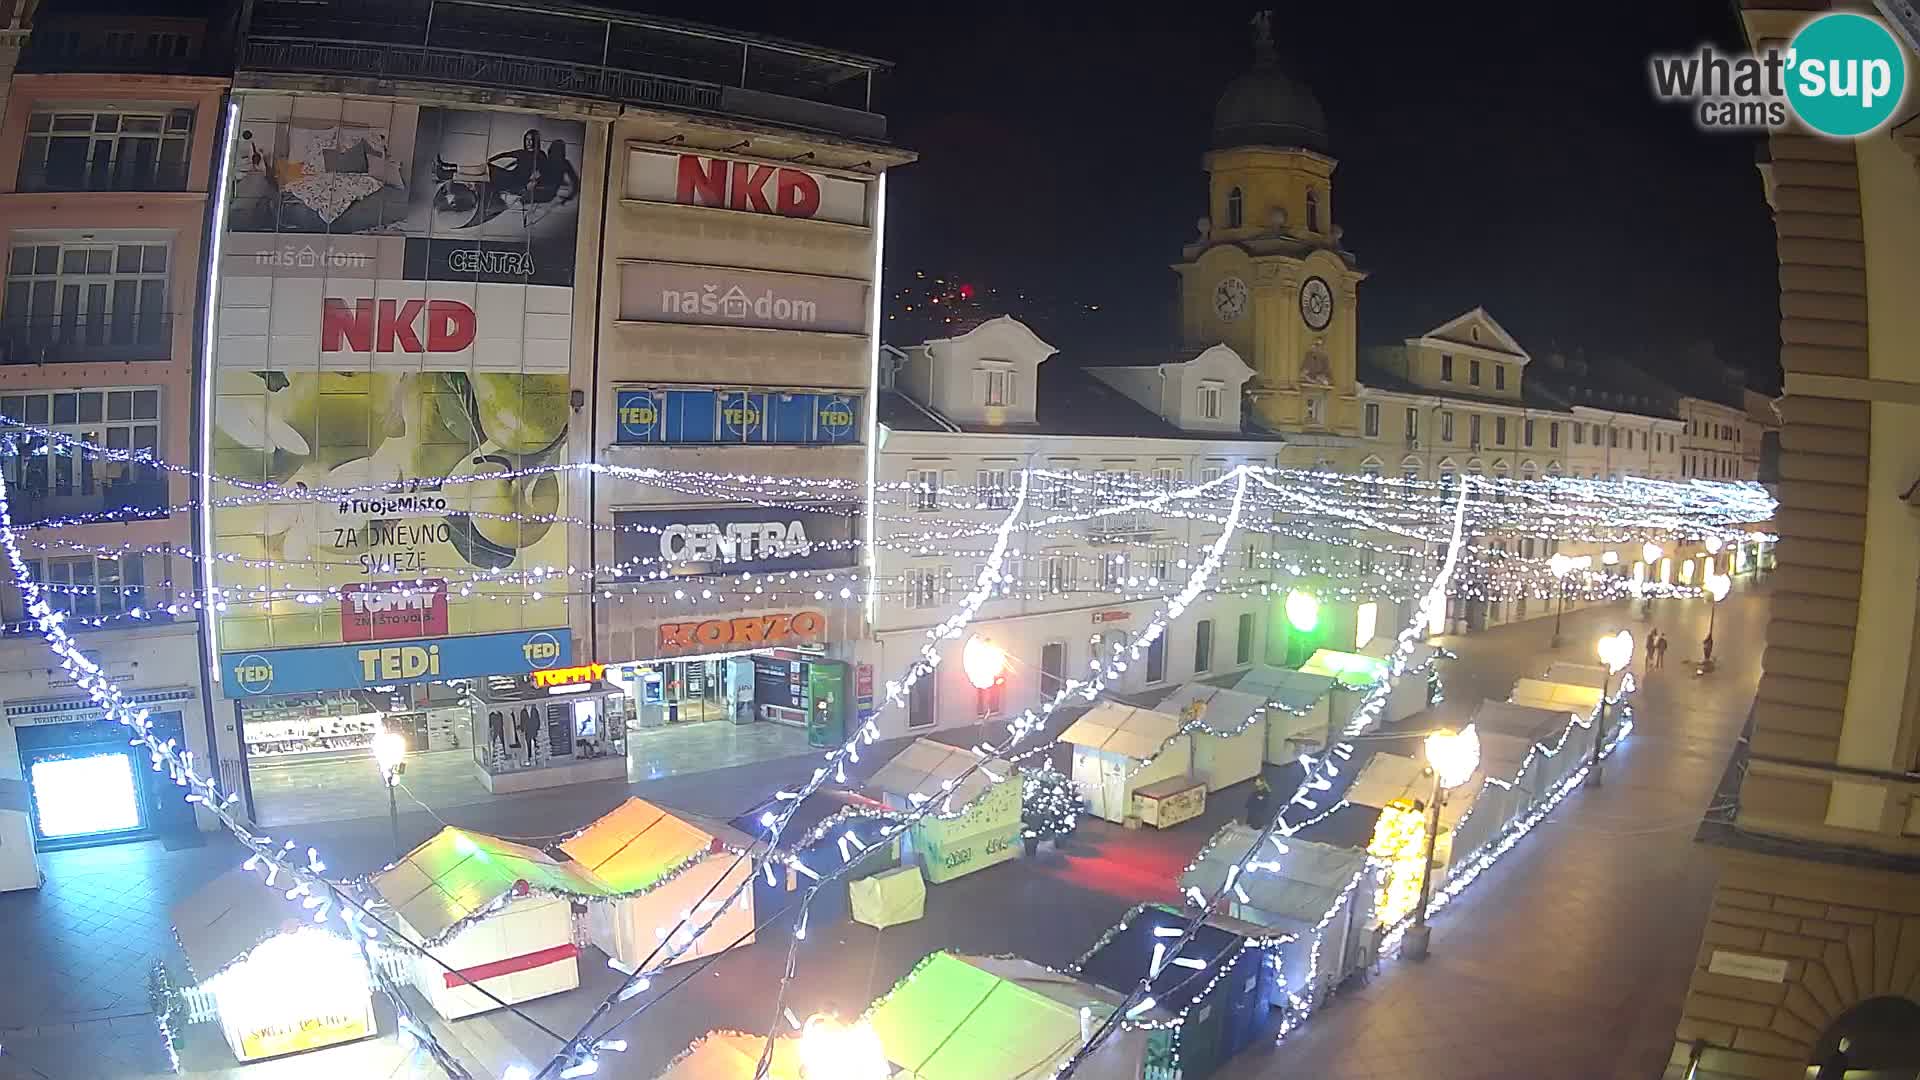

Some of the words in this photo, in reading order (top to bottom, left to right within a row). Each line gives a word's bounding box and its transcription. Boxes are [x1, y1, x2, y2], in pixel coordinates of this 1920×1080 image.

[676, 153, 821, 219] NKD
[448, 249, 535, 275] CENTRA
[661, 283, 718, 317] naš
[754, 288, 817, 323] dom
[322, 297, 478, 354] NKD
[618, 407, 658, 425] TEDi
[723, 409, 760, 426] TEDi
[820, 411, 854, 427] TEDi
[339, 496, 446, 516] #TvojeMisto
[334, 528, 358, 549] ZA
[369, 523, 451, 547] DNEVNO
[660, 520, 810, 562] CENTRA
[351, 588, 440, 614] TOMMY
[659, 611, 826, 648] KORZO
[522, 642, 561, 659] TEDi
[234, 665, 274, 684] TEDi
[357, 645, 440, 681] TEDi
[533, 663, 605, 687] TOMMY
